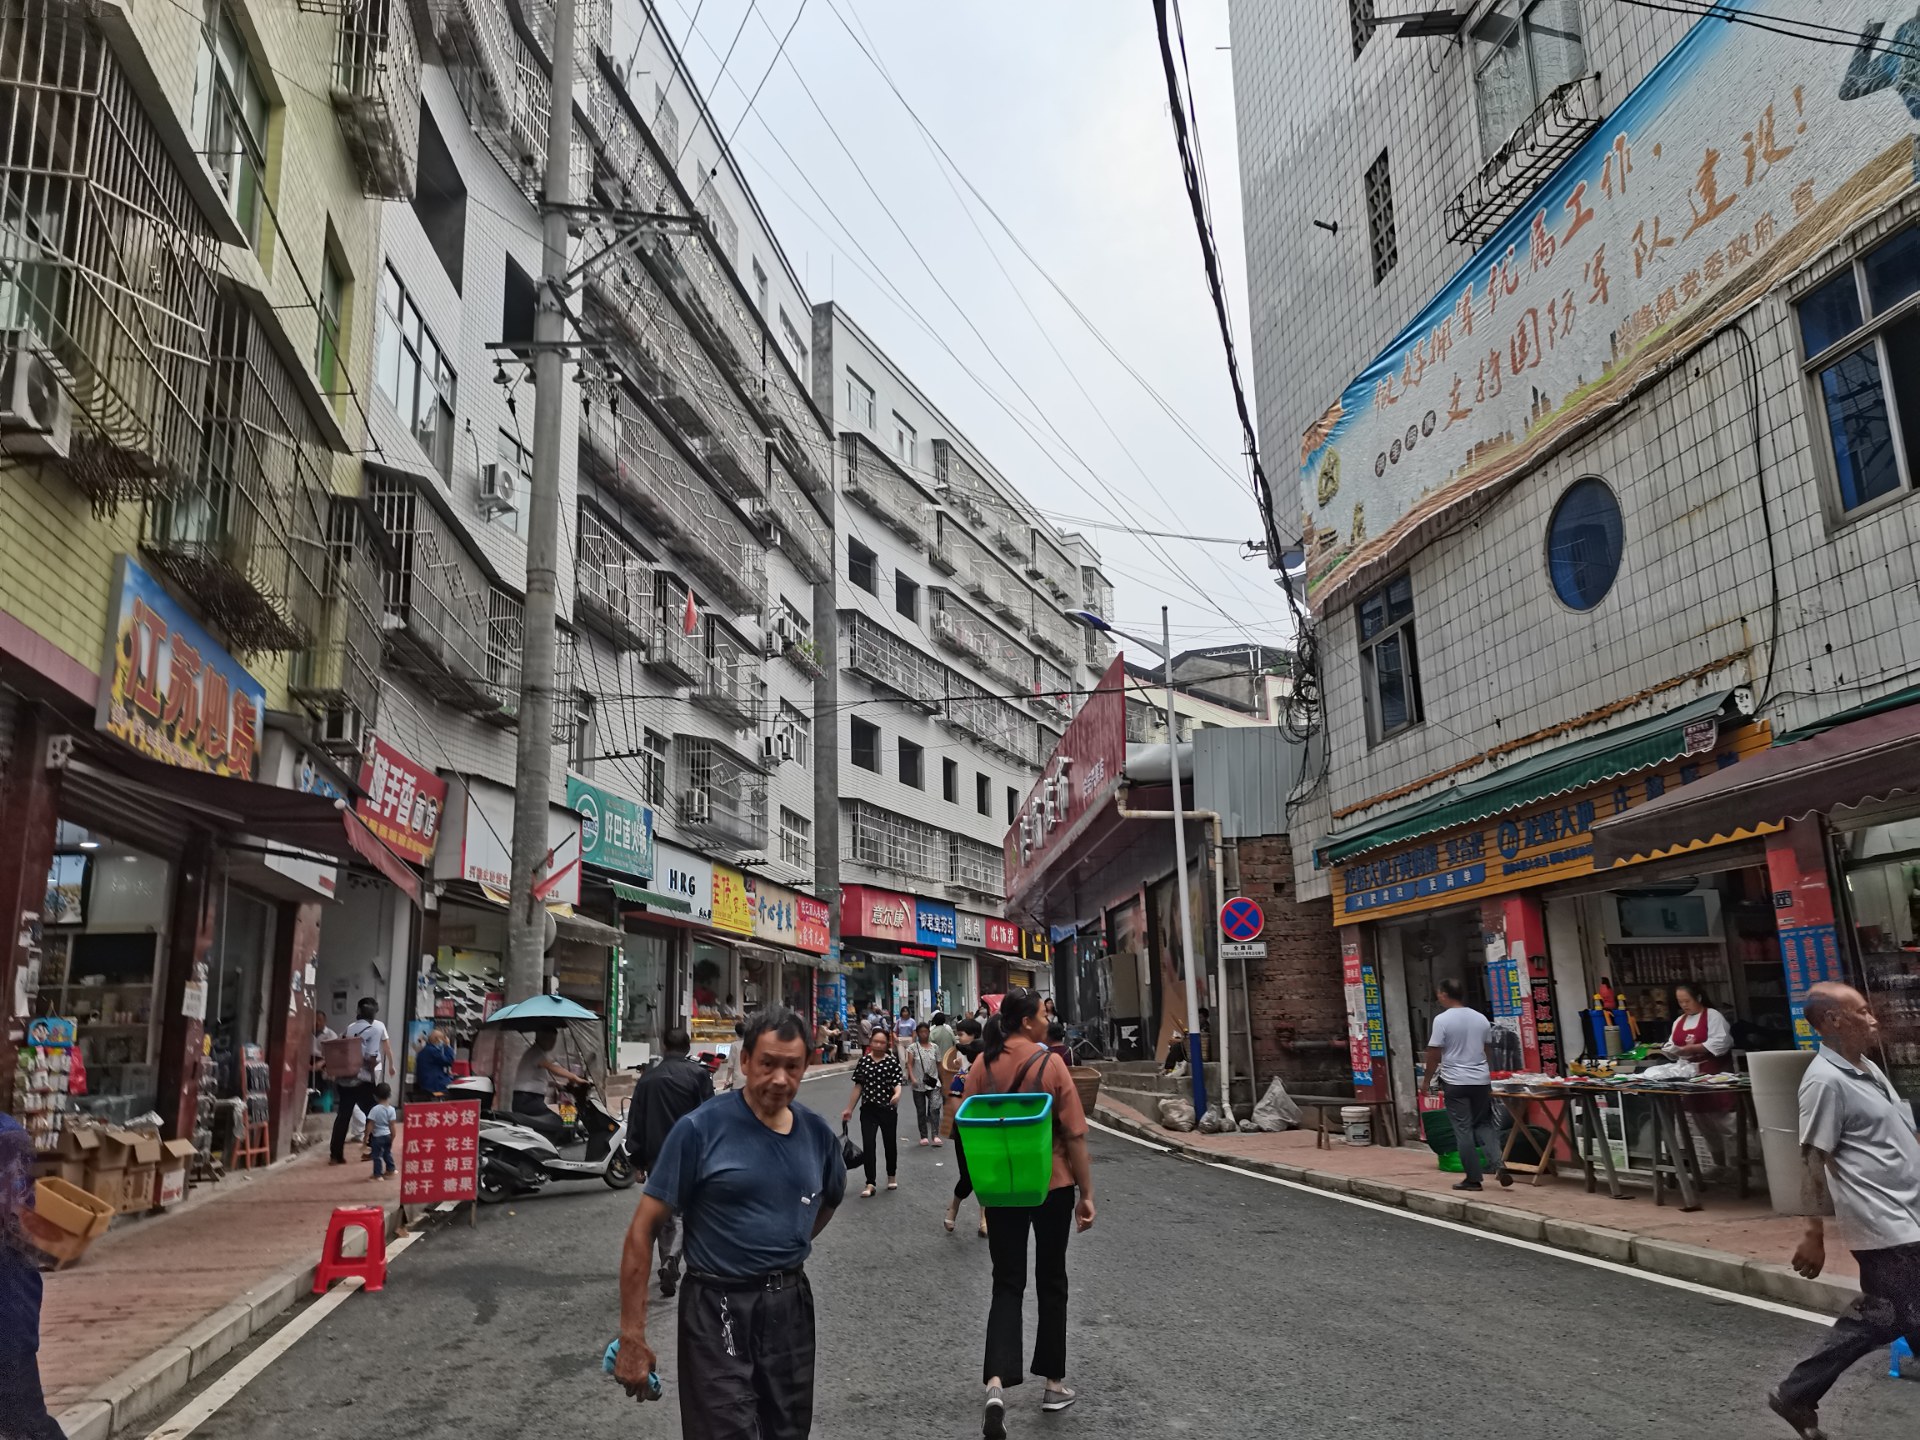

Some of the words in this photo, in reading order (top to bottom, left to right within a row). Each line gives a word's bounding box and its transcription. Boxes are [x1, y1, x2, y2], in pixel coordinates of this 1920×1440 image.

[1615, 211, 1778, 350] 兴隆镇党委政府
[124, 596, 257, 781] 江苏炒货
[668, 868, 696, 896] HRG
[757, 895, 793, 932] 开心童装
[871, 905, 905, 928] 意尔康
[406, 1108, 477, 1129] 江苏炒货
[406, 1139, 436, 1154] 瓜子
[445, 1136, 475, 1152] 花生
[404, 1159, 435, 1175] 豌豆
[444, 1156, 474, 1172] 胡豆
[404, 1179, 434, 1195] 饼干
[443, 1176, 473, 1193] 糖果
